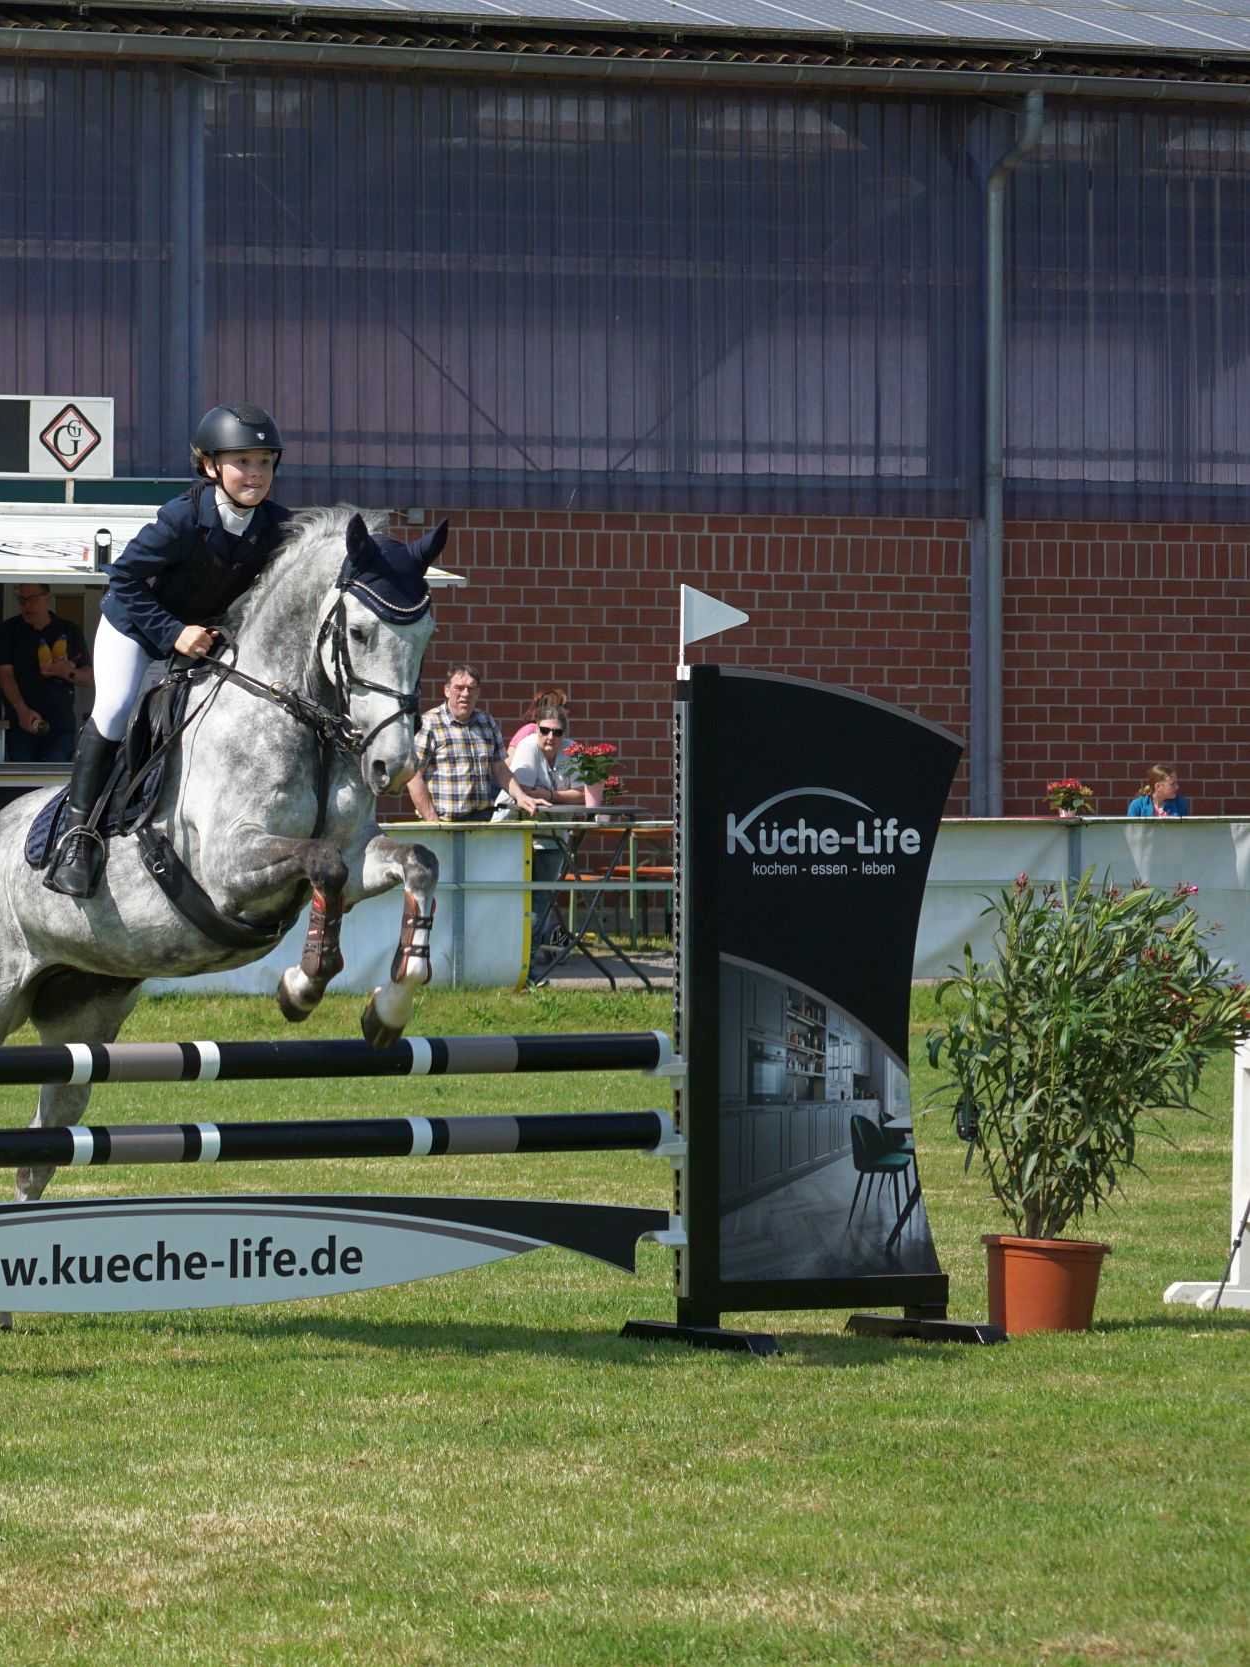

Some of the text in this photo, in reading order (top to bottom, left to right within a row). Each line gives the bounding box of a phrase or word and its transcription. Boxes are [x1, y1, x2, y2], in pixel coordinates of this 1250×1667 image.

[726, 812, 921, 855] Küche-Life
[752, 861, 797, 876] kochen
[811, 863, 848, 875] essen
[862, 861, 896, 875] leben
